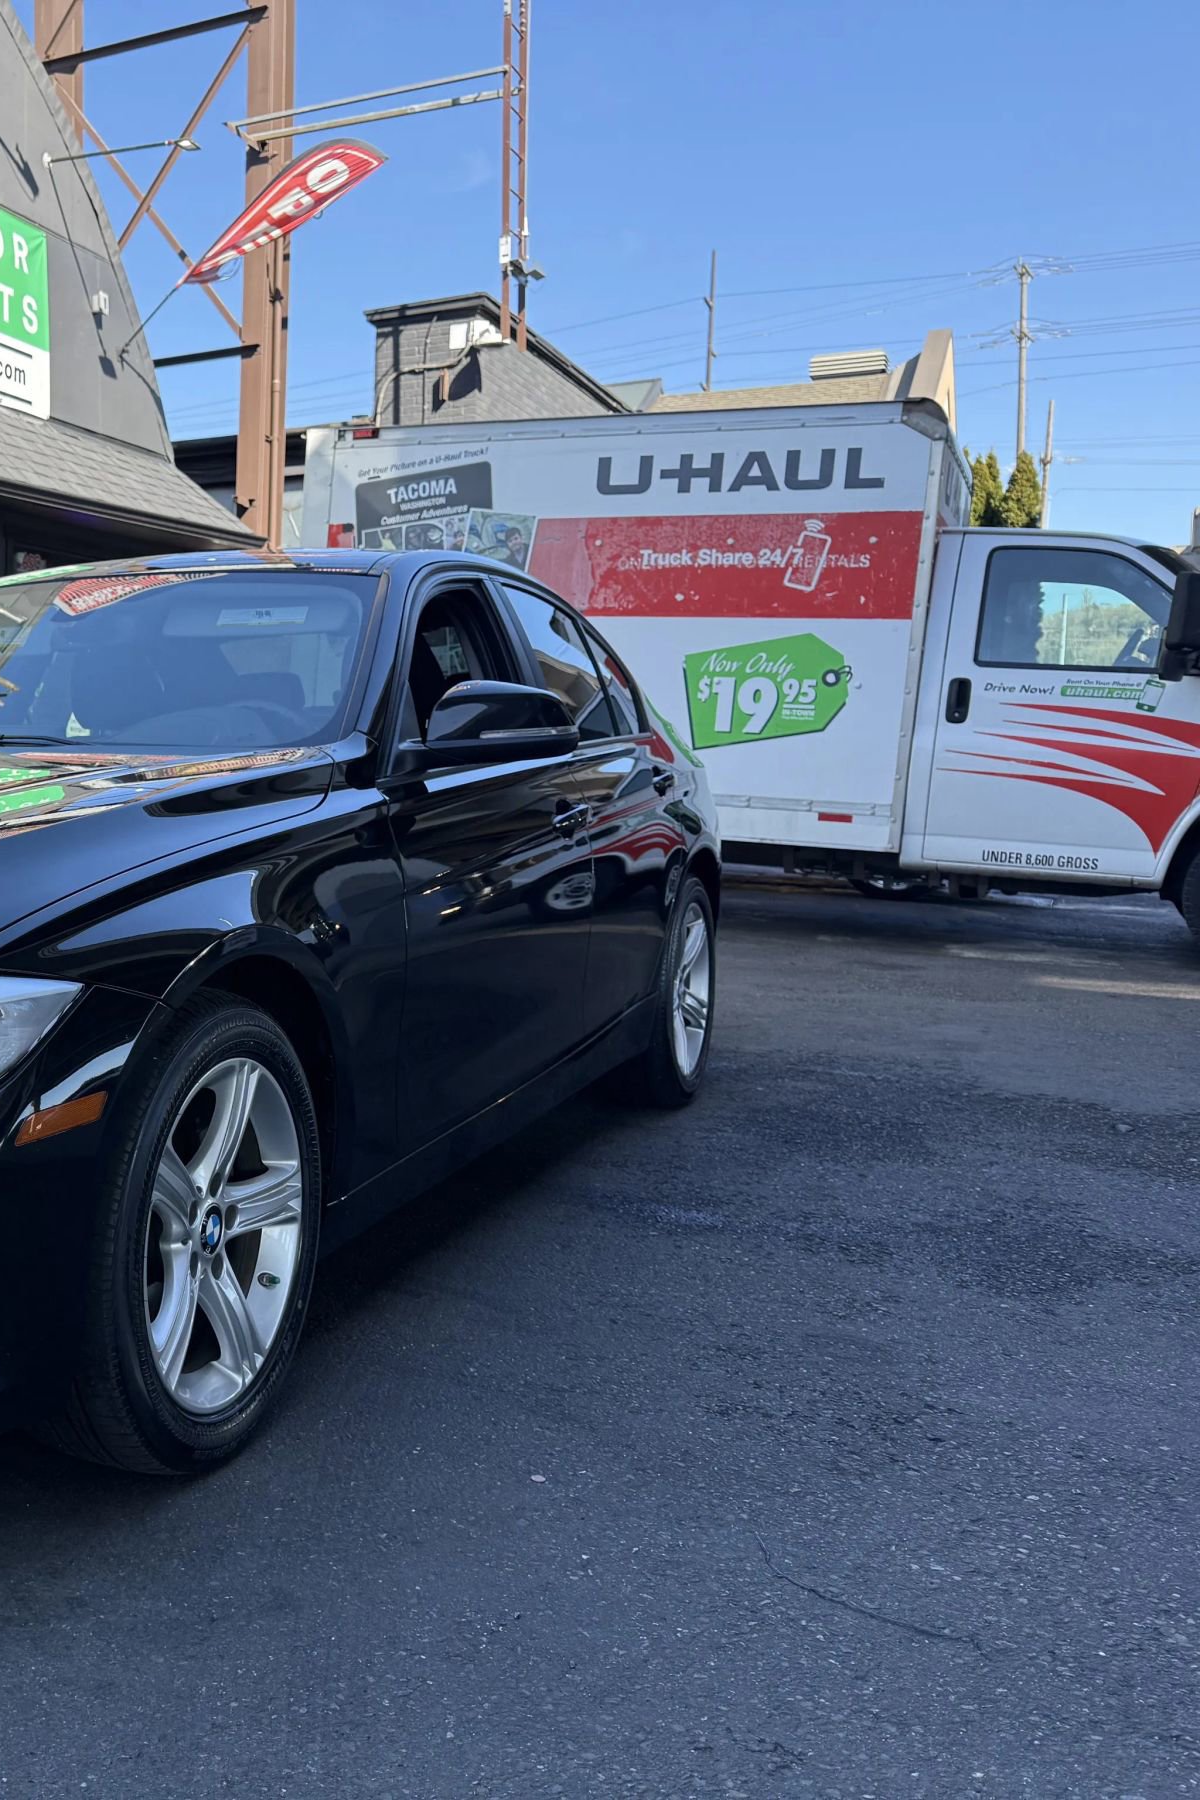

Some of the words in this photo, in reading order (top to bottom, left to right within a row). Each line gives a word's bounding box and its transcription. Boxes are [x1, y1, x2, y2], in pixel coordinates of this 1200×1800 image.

[390, 460, 417, 473] Picture
[418, 459, 428, 468] on
[435, 451, 462, 464] U-Haul
[463, 446, 489, 459] Truck!
[596, 447, 886, 496] U-HAUL
[387, 478, 458, 504] TACOMA
[400, 496, 446, 511] WASHINGTON
[380, 511, 420, 526] Customer
[420, 504, 469, 519] Adventures
[640, 549, 693, 566] Truck
[696, 548, 753, 566] Share
[759, 545, 804, 566] 24/7
[700, 652, 743, 673] Now
[744, 652, 796, 682] Only
[984, 682, 1017, 694] Drive
[1019, 684, 1056, 695] Now!
[1065, 685, 1145, 700] uhaul.com
[982, 849, 1023, 865] UNDER
[1025, 853, 1054, 867] 8,600
[1057, 855, 1100, 870] GROSS
